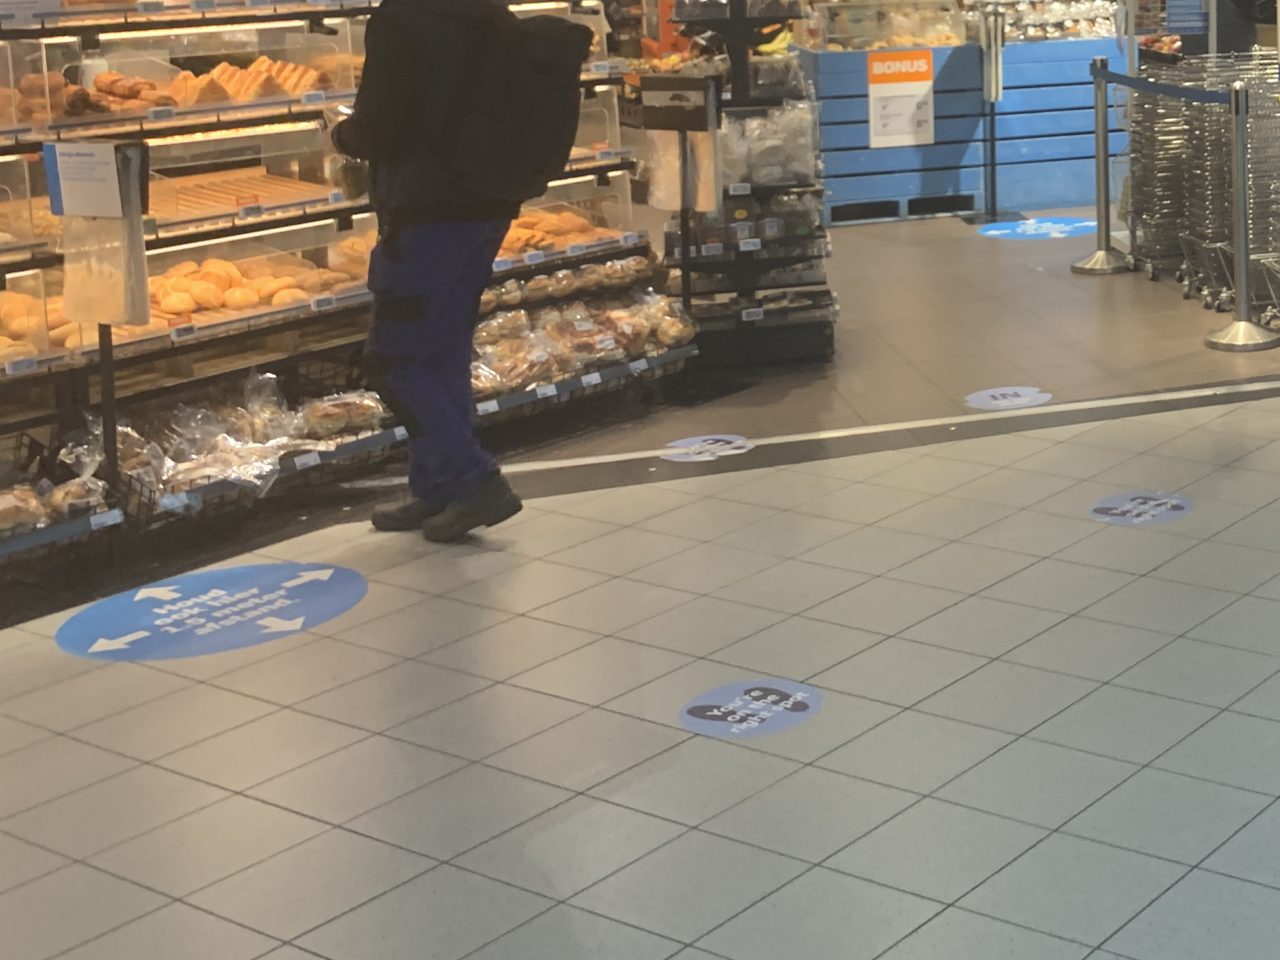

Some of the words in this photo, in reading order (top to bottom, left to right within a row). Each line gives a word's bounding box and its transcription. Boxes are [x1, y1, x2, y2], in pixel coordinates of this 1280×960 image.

[873, 58, 929, 75] BONUS
[727, 708, 753, 722] on
[748, 694, 780, 709] the
[730, 711, 774, 733] right
[772, 692, 810, 712] spot
